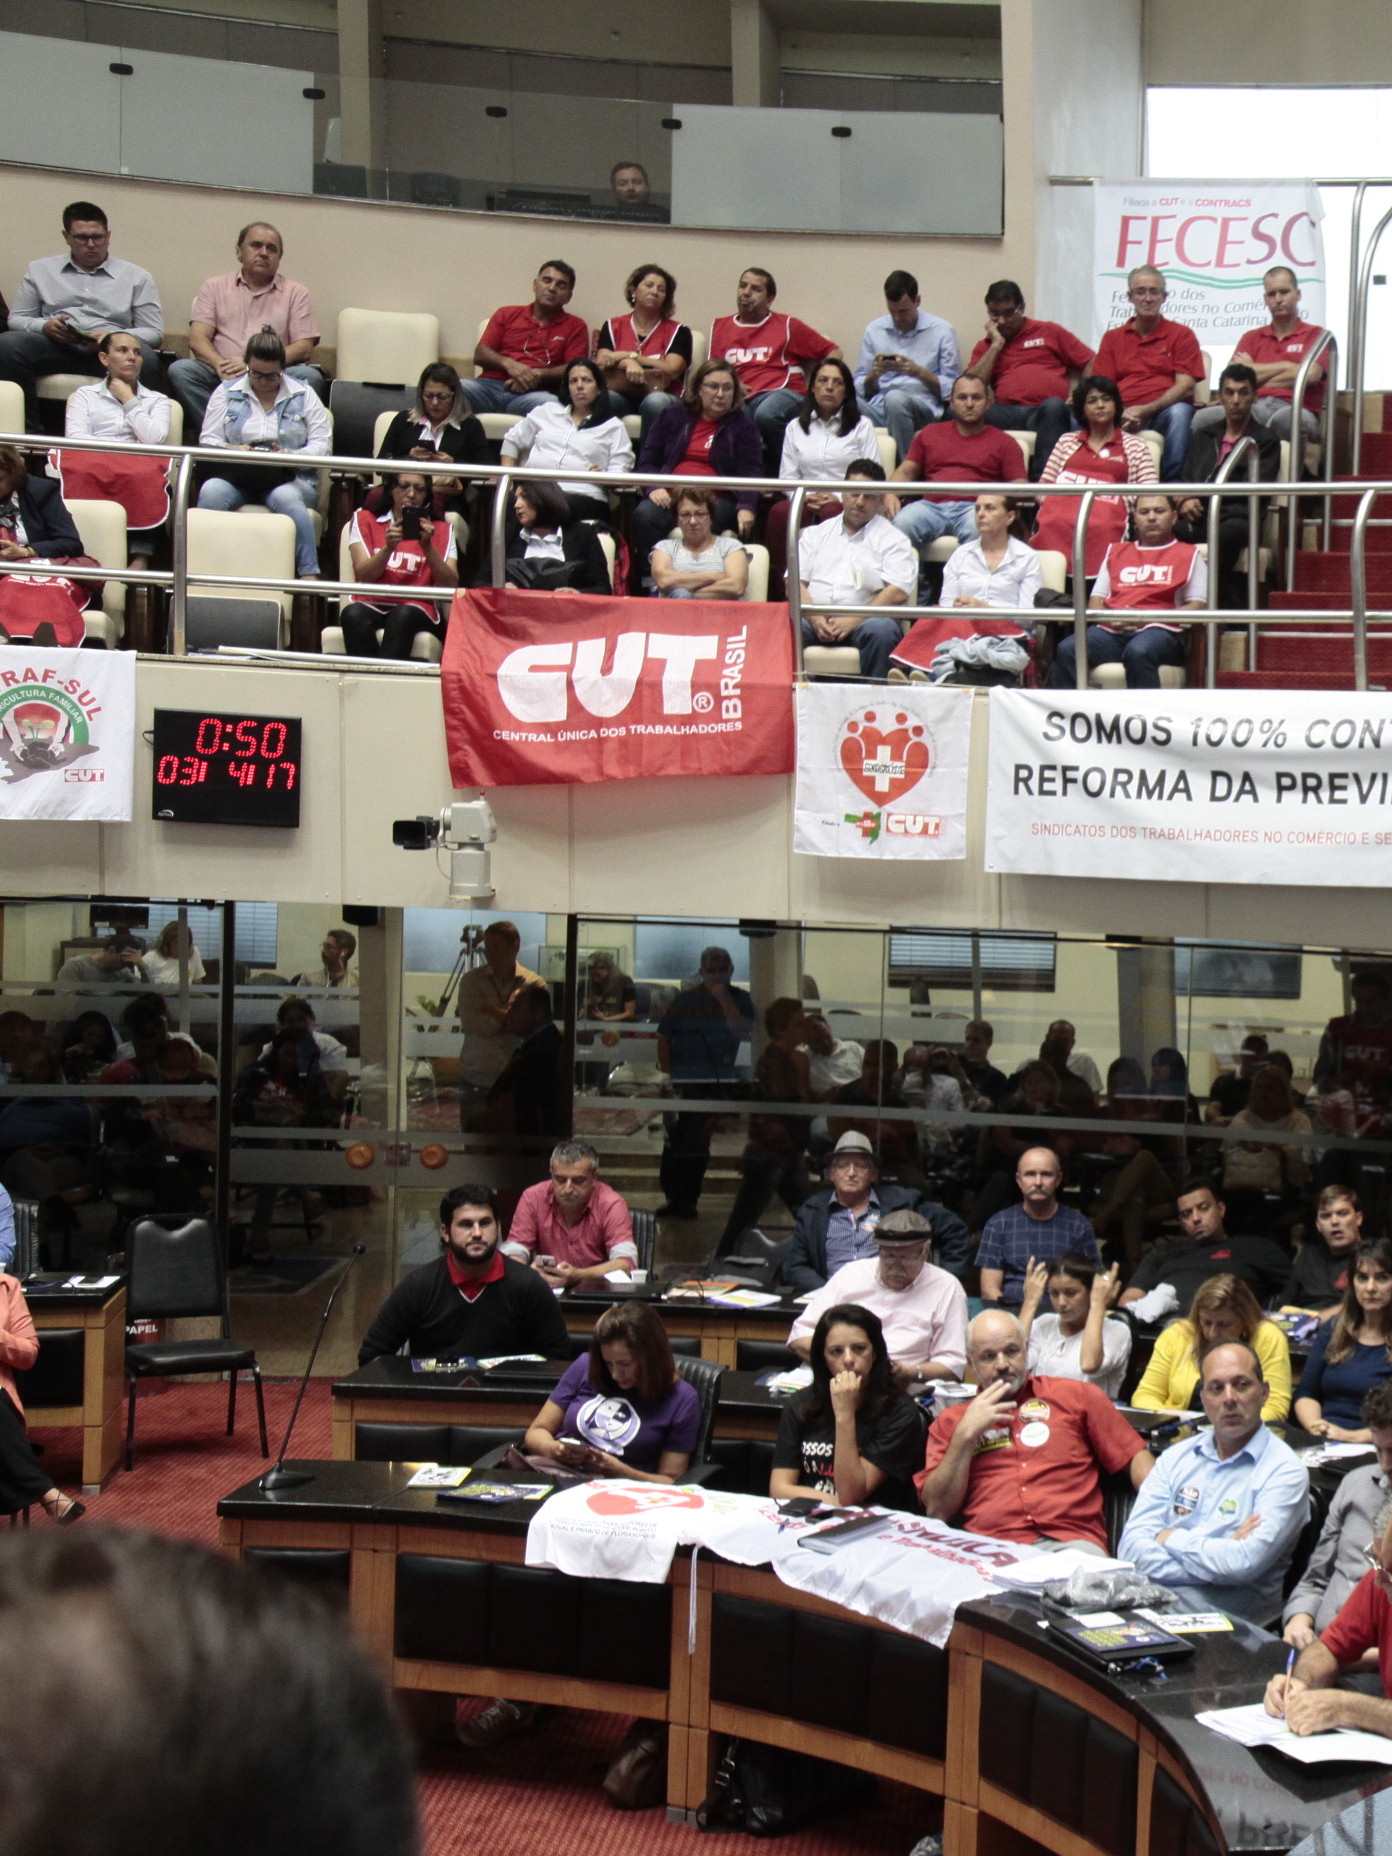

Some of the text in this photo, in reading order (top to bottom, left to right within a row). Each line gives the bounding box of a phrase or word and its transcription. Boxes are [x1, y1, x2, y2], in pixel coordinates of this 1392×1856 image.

[1159, 197, 1180, 207] CUT
[1195, 198, 1252, 208] CONTRACS
[1115, 211, 1317, 268] FECESC
[1180, 288, 1205, 301] dos
[1201, 303, 1219, 315] no
[1213, 314, 1268, 328] Catarina
[725, 346, 769, 364] CUT
[387, 551, 421, 572] UT
[1120, 564, 1169, 584] CUT
[497, 631, 720, 723] CUT
[720, 624, 748, 720] BRASIL
[0, 667, 103, 722] RAF-SUL
[48, 692, 83, 724] FAMILIAR
[196, 718, 287, 759] 0:50
[493, 721, 742, 743] CENTRAL ÚNICA DOS TRABALHADORES
[1042, 710, 1173, 747] SOMOS
[1191, 717, 1287, 749] 100%
[65, 769, 104, 782] CUT
[1013, 763, 1193, 803] REFORMA
[1209, 770, 1260, 804] DA
[887, 814, 940, 835] CUT
[1031, 823, 1106, 838] SINDICATOS
[1110, 825, 1137, 839] DOS
[1141, 826, 1258, 843] TRABALHADORES
[1263, 831, 1282, 843] NO
[1287, 828, 1356, 845] COMÉRCIO
[1361, 832, 1369, 845] E
